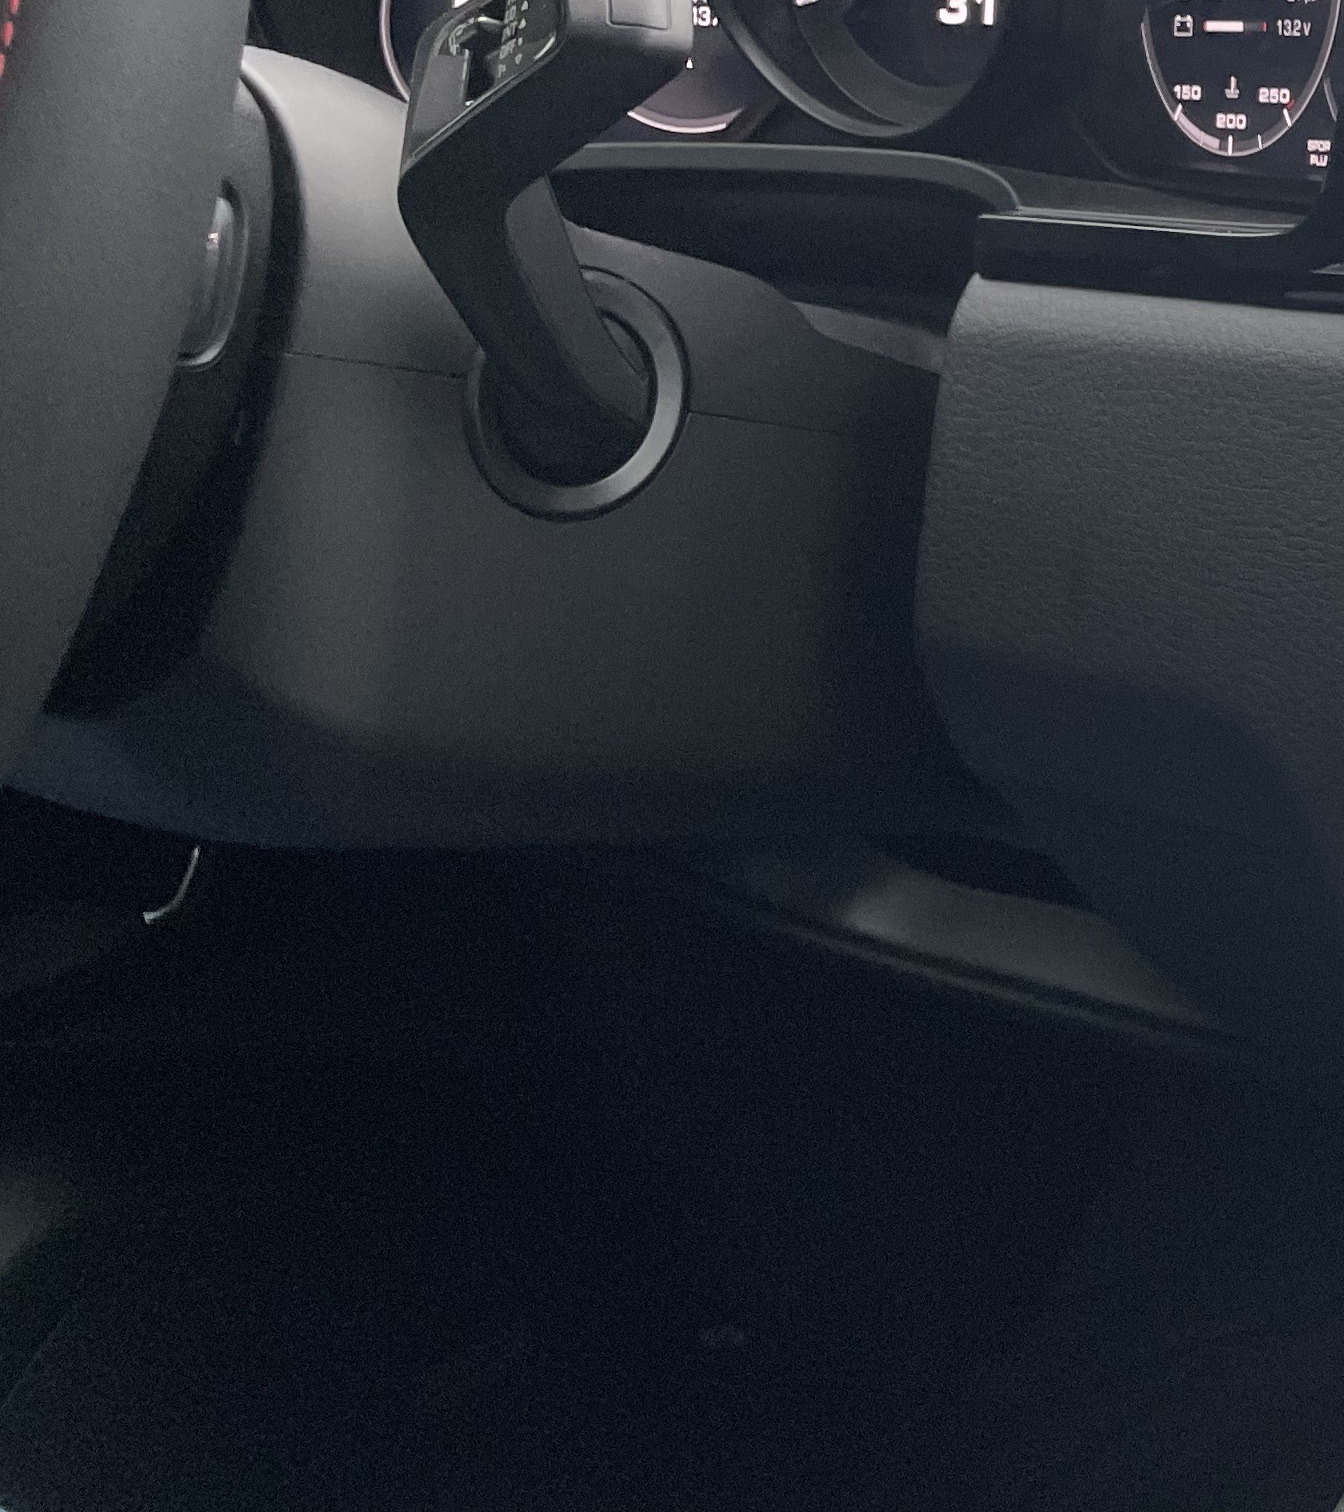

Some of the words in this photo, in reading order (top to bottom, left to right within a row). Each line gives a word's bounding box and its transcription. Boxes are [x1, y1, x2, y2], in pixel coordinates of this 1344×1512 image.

[1173, 84, 1202, 101] 150
[1258, 87, 1290, 104] 250
[1215, 113, 1247, 131] 200
